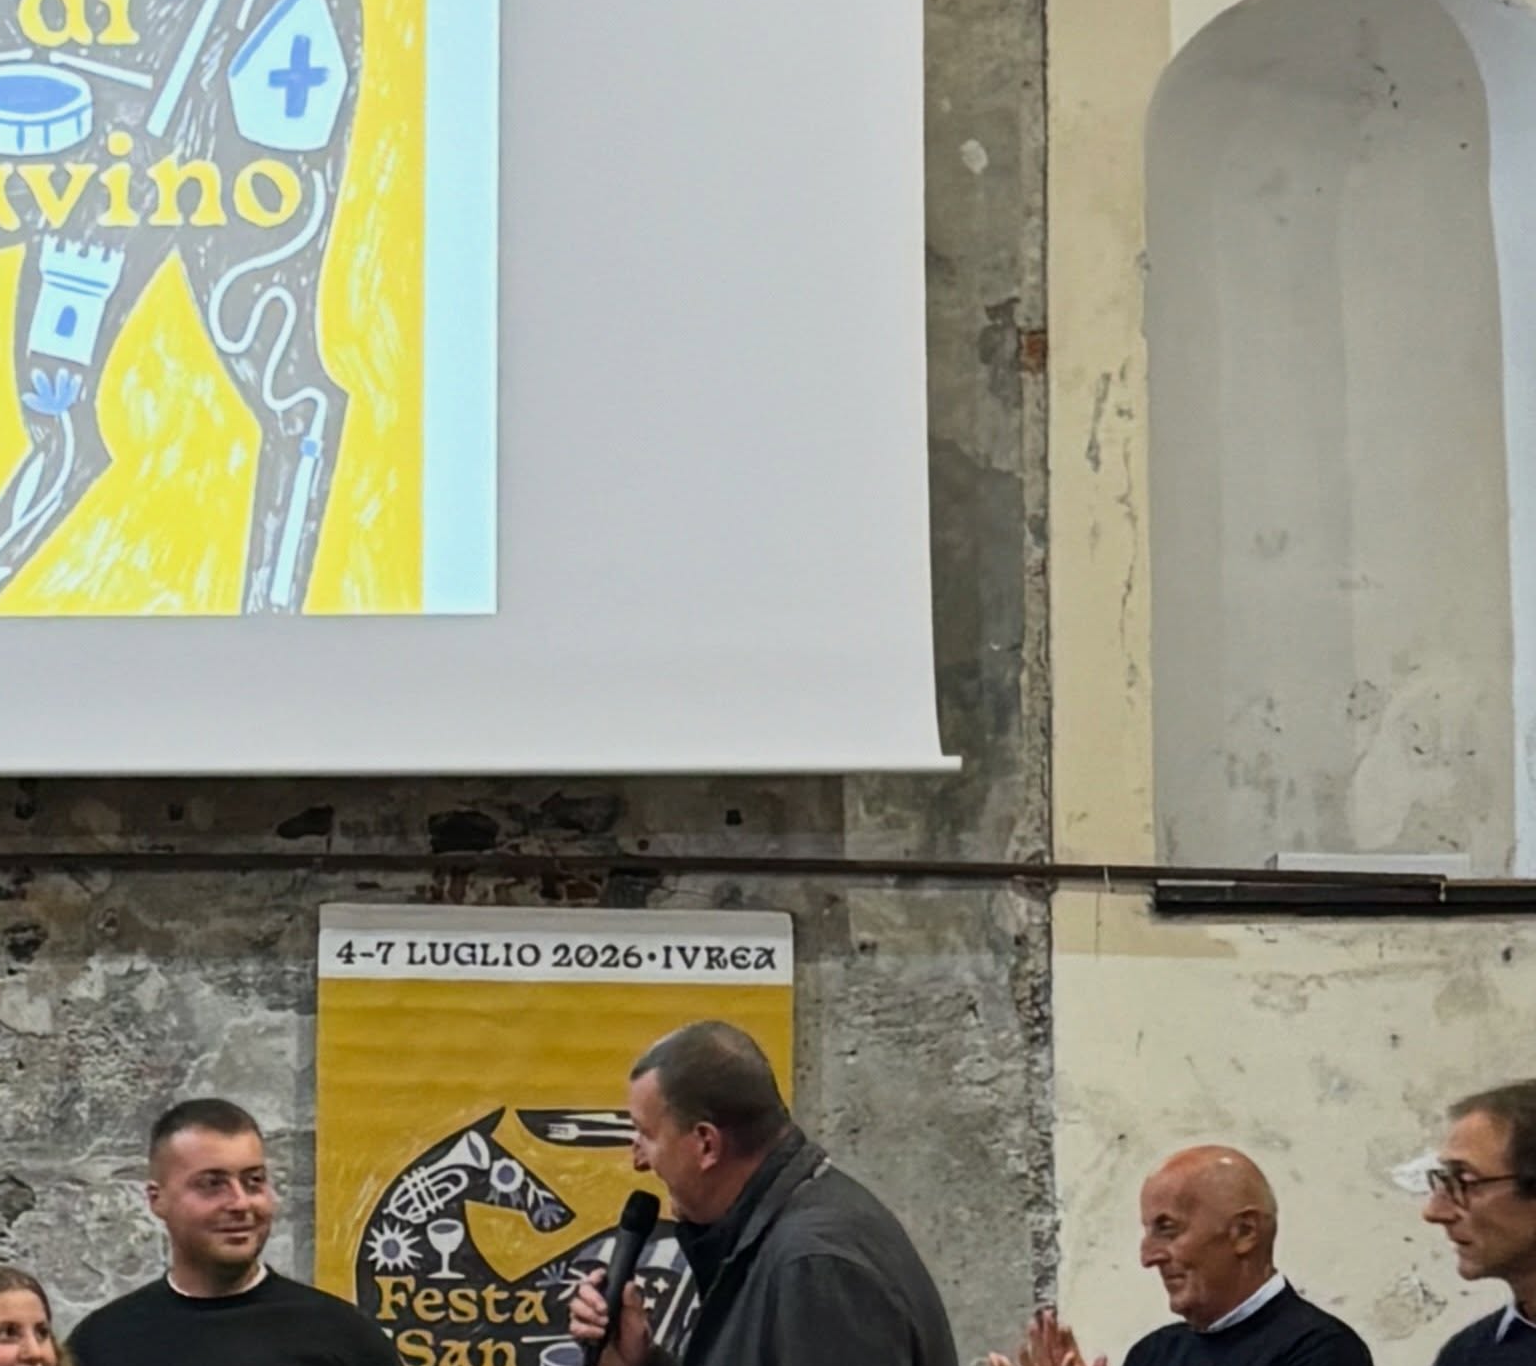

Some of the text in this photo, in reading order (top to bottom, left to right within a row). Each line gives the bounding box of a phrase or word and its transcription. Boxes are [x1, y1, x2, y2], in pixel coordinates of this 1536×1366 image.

[336, 941, 396, 966] 4-7
[406, 942, 541, 968] LUGLIO
[373, 1274, 551, 1325] Festa
